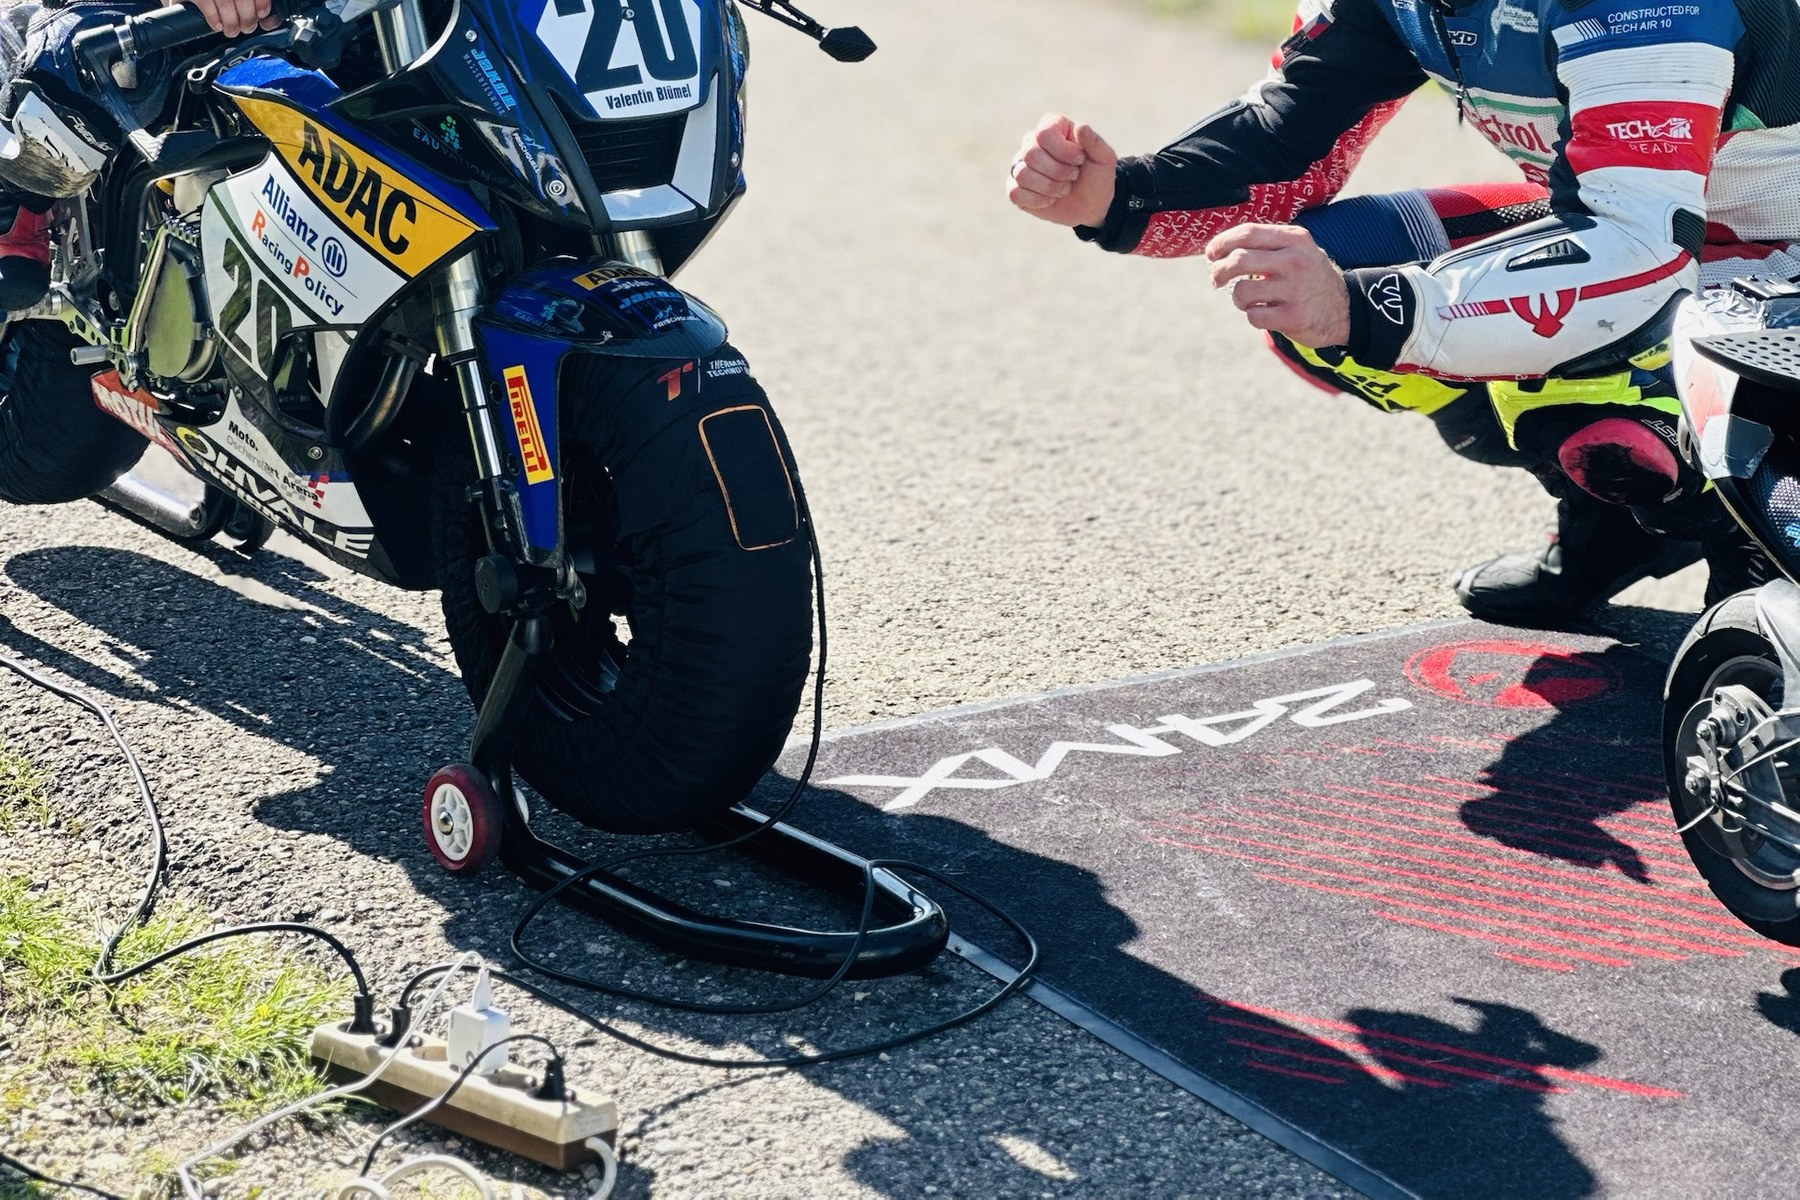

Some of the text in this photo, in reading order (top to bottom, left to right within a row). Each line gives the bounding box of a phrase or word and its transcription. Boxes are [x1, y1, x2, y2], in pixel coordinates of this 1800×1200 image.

[1607, 5, 1700, 24] CONSTRUCTED FOR
[1609, 18, 1672, 35] TECH AIR 10
[605, 83, 692, 111] Valentin Blümel
[1628, 142, 1678, 154] READY
[261, 173, 319, 251] Allianz
[297, 119, 417, 256] ADAC
[219, 237, 293, 382] 20
[507, 375, 548, 473] PIRELLI
[815, 679, 1415, 813] 24MX
